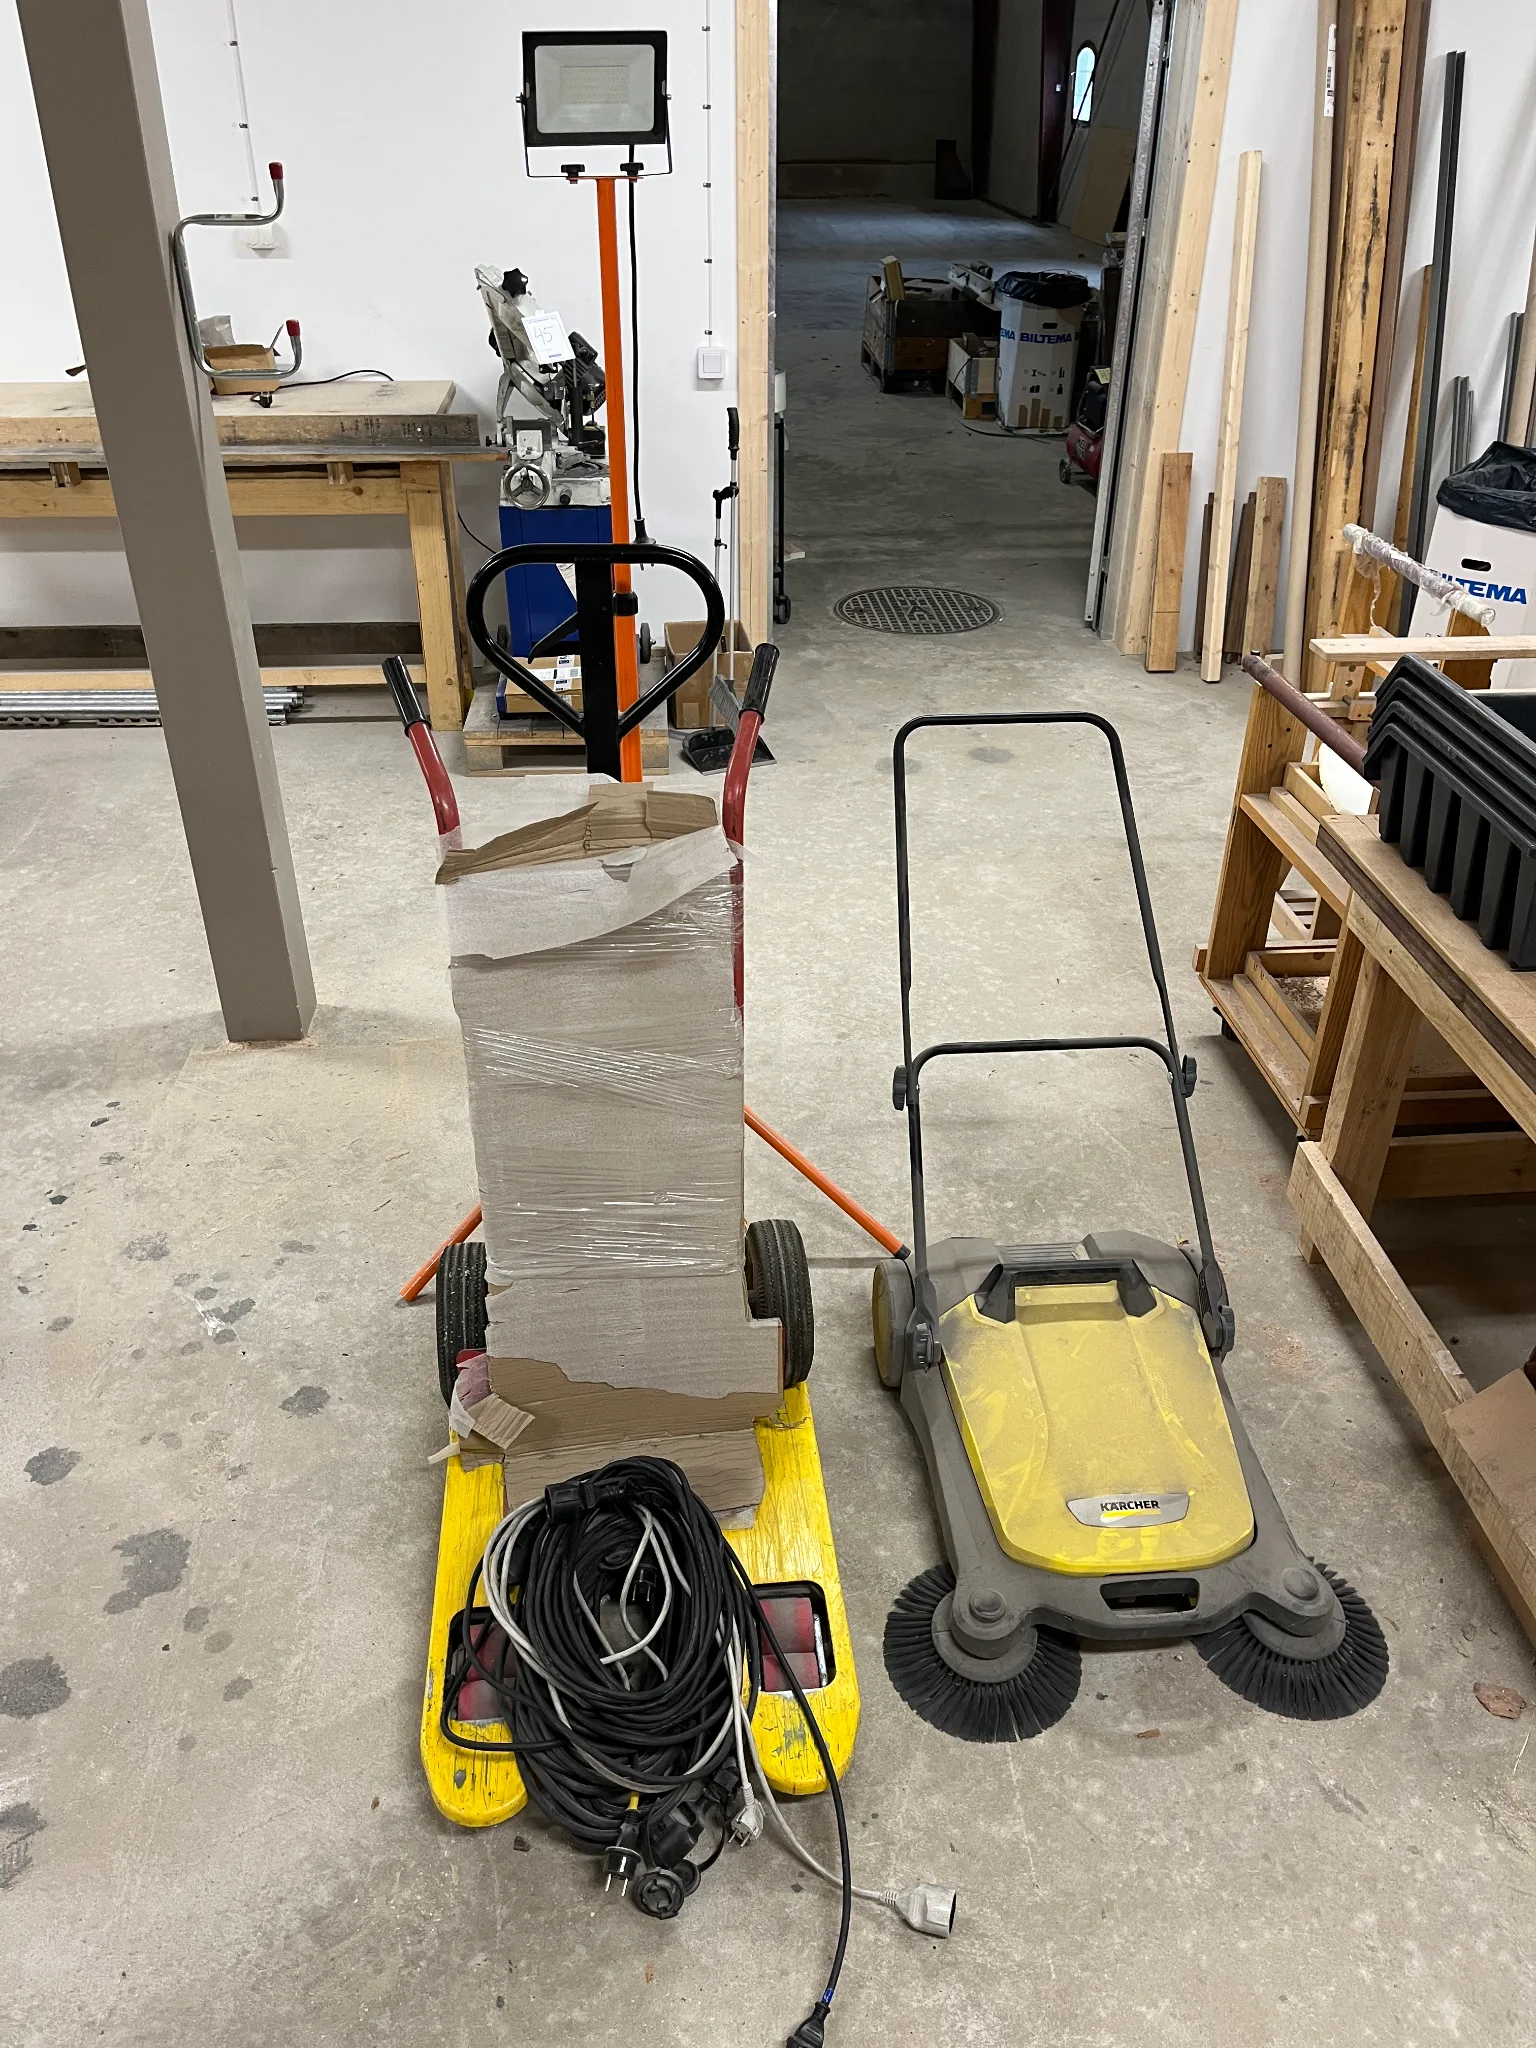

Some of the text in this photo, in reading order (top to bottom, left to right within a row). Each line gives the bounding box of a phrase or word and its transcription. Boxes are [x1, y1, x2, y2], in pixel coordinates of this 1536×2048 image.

[1019, 332, 1072, 344] BILTEMA
[1430, 569, 1527, 604] TEMA
[1100, 1500, 1160, 1511] KÄRCHER
